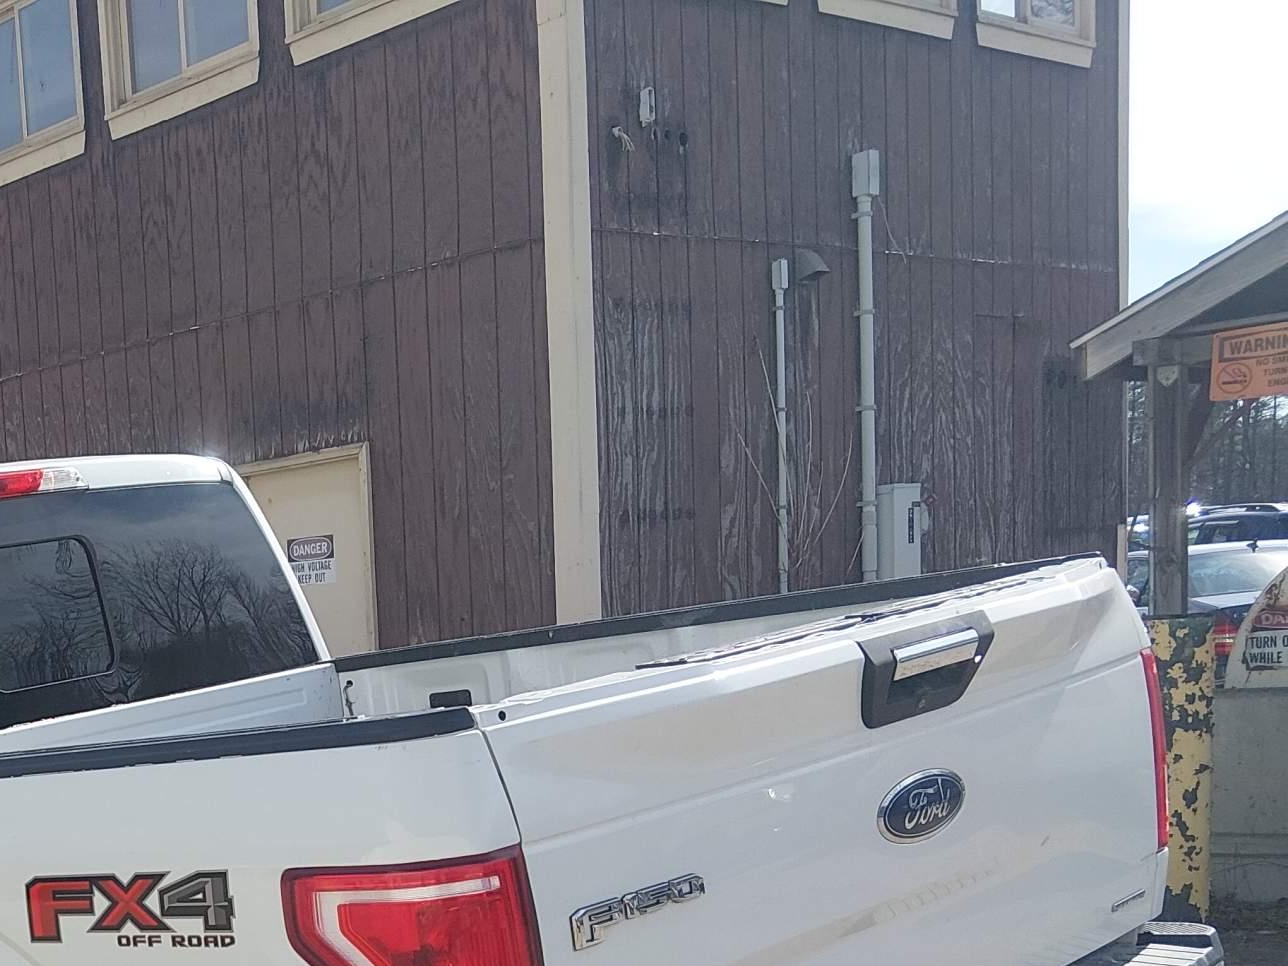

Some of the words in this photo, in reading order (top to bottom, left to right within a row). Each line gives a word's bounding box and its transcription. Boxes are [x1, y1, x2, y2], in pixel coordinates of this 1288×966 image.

[293, 542, 328, 556] DANGER
[308, 560, 332, 572] VOLTAGE
[297, 574, 312, 584] KEEP
[314, 572, 326, 583] OUT
[1250, 635, 1277, 649] TURN
[1249, 651, 1283, 664] WHILE
[904, 777, 951, 829] Ford
[26, 868, 236, 943] FX4
[117, 934, 162, 948] OFF
[171, 934, 236, 948] ROAD
